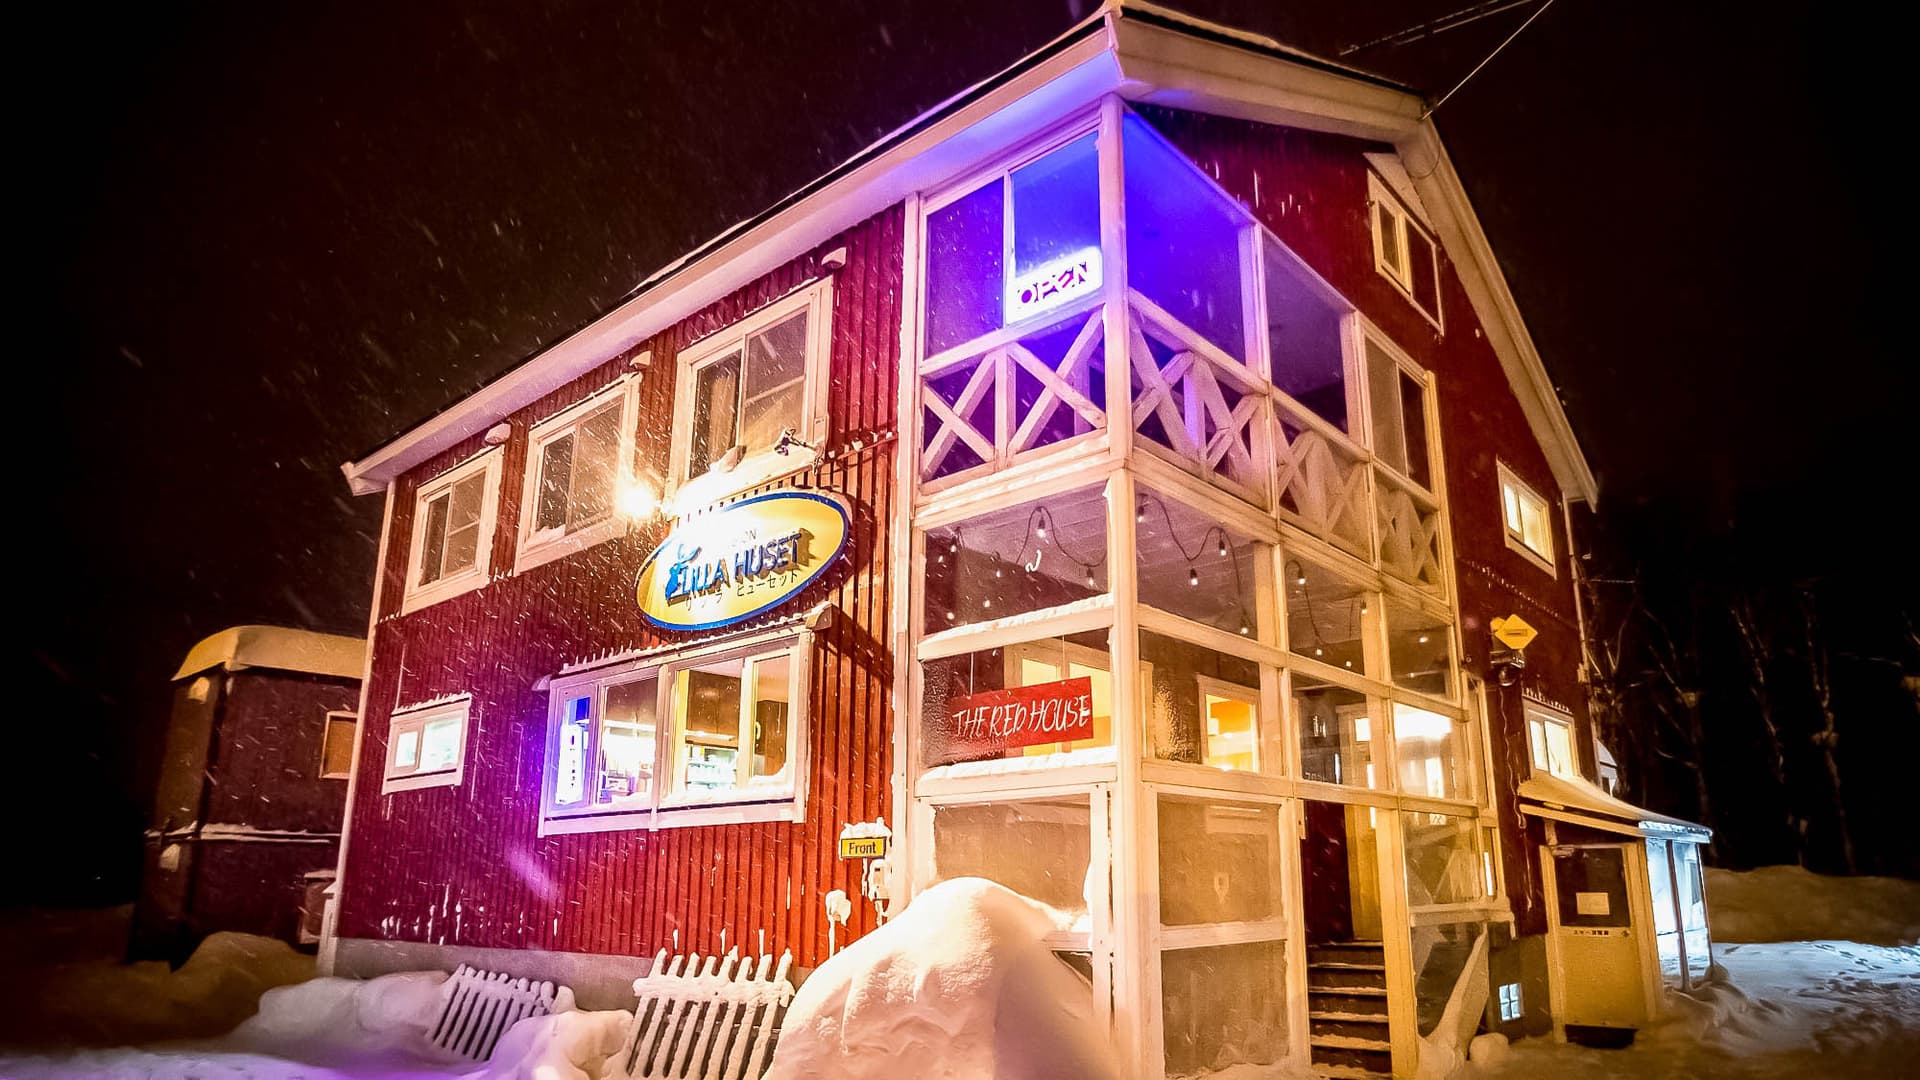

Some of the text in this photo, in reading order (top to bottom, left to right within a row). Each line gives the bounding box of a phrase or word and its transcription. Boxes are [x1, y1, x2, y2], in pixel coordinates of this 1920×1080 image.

[1017, 259, 1090, 305] OPEN
[681, 559, 728, 596] LILLA
[735, 533, 801, 577] HUSET
[737, 569, 798, 597] ヒューセット
[952, 695, 1090, 738] THE RED HOUSE
[848, 841, 876, 855] Front
